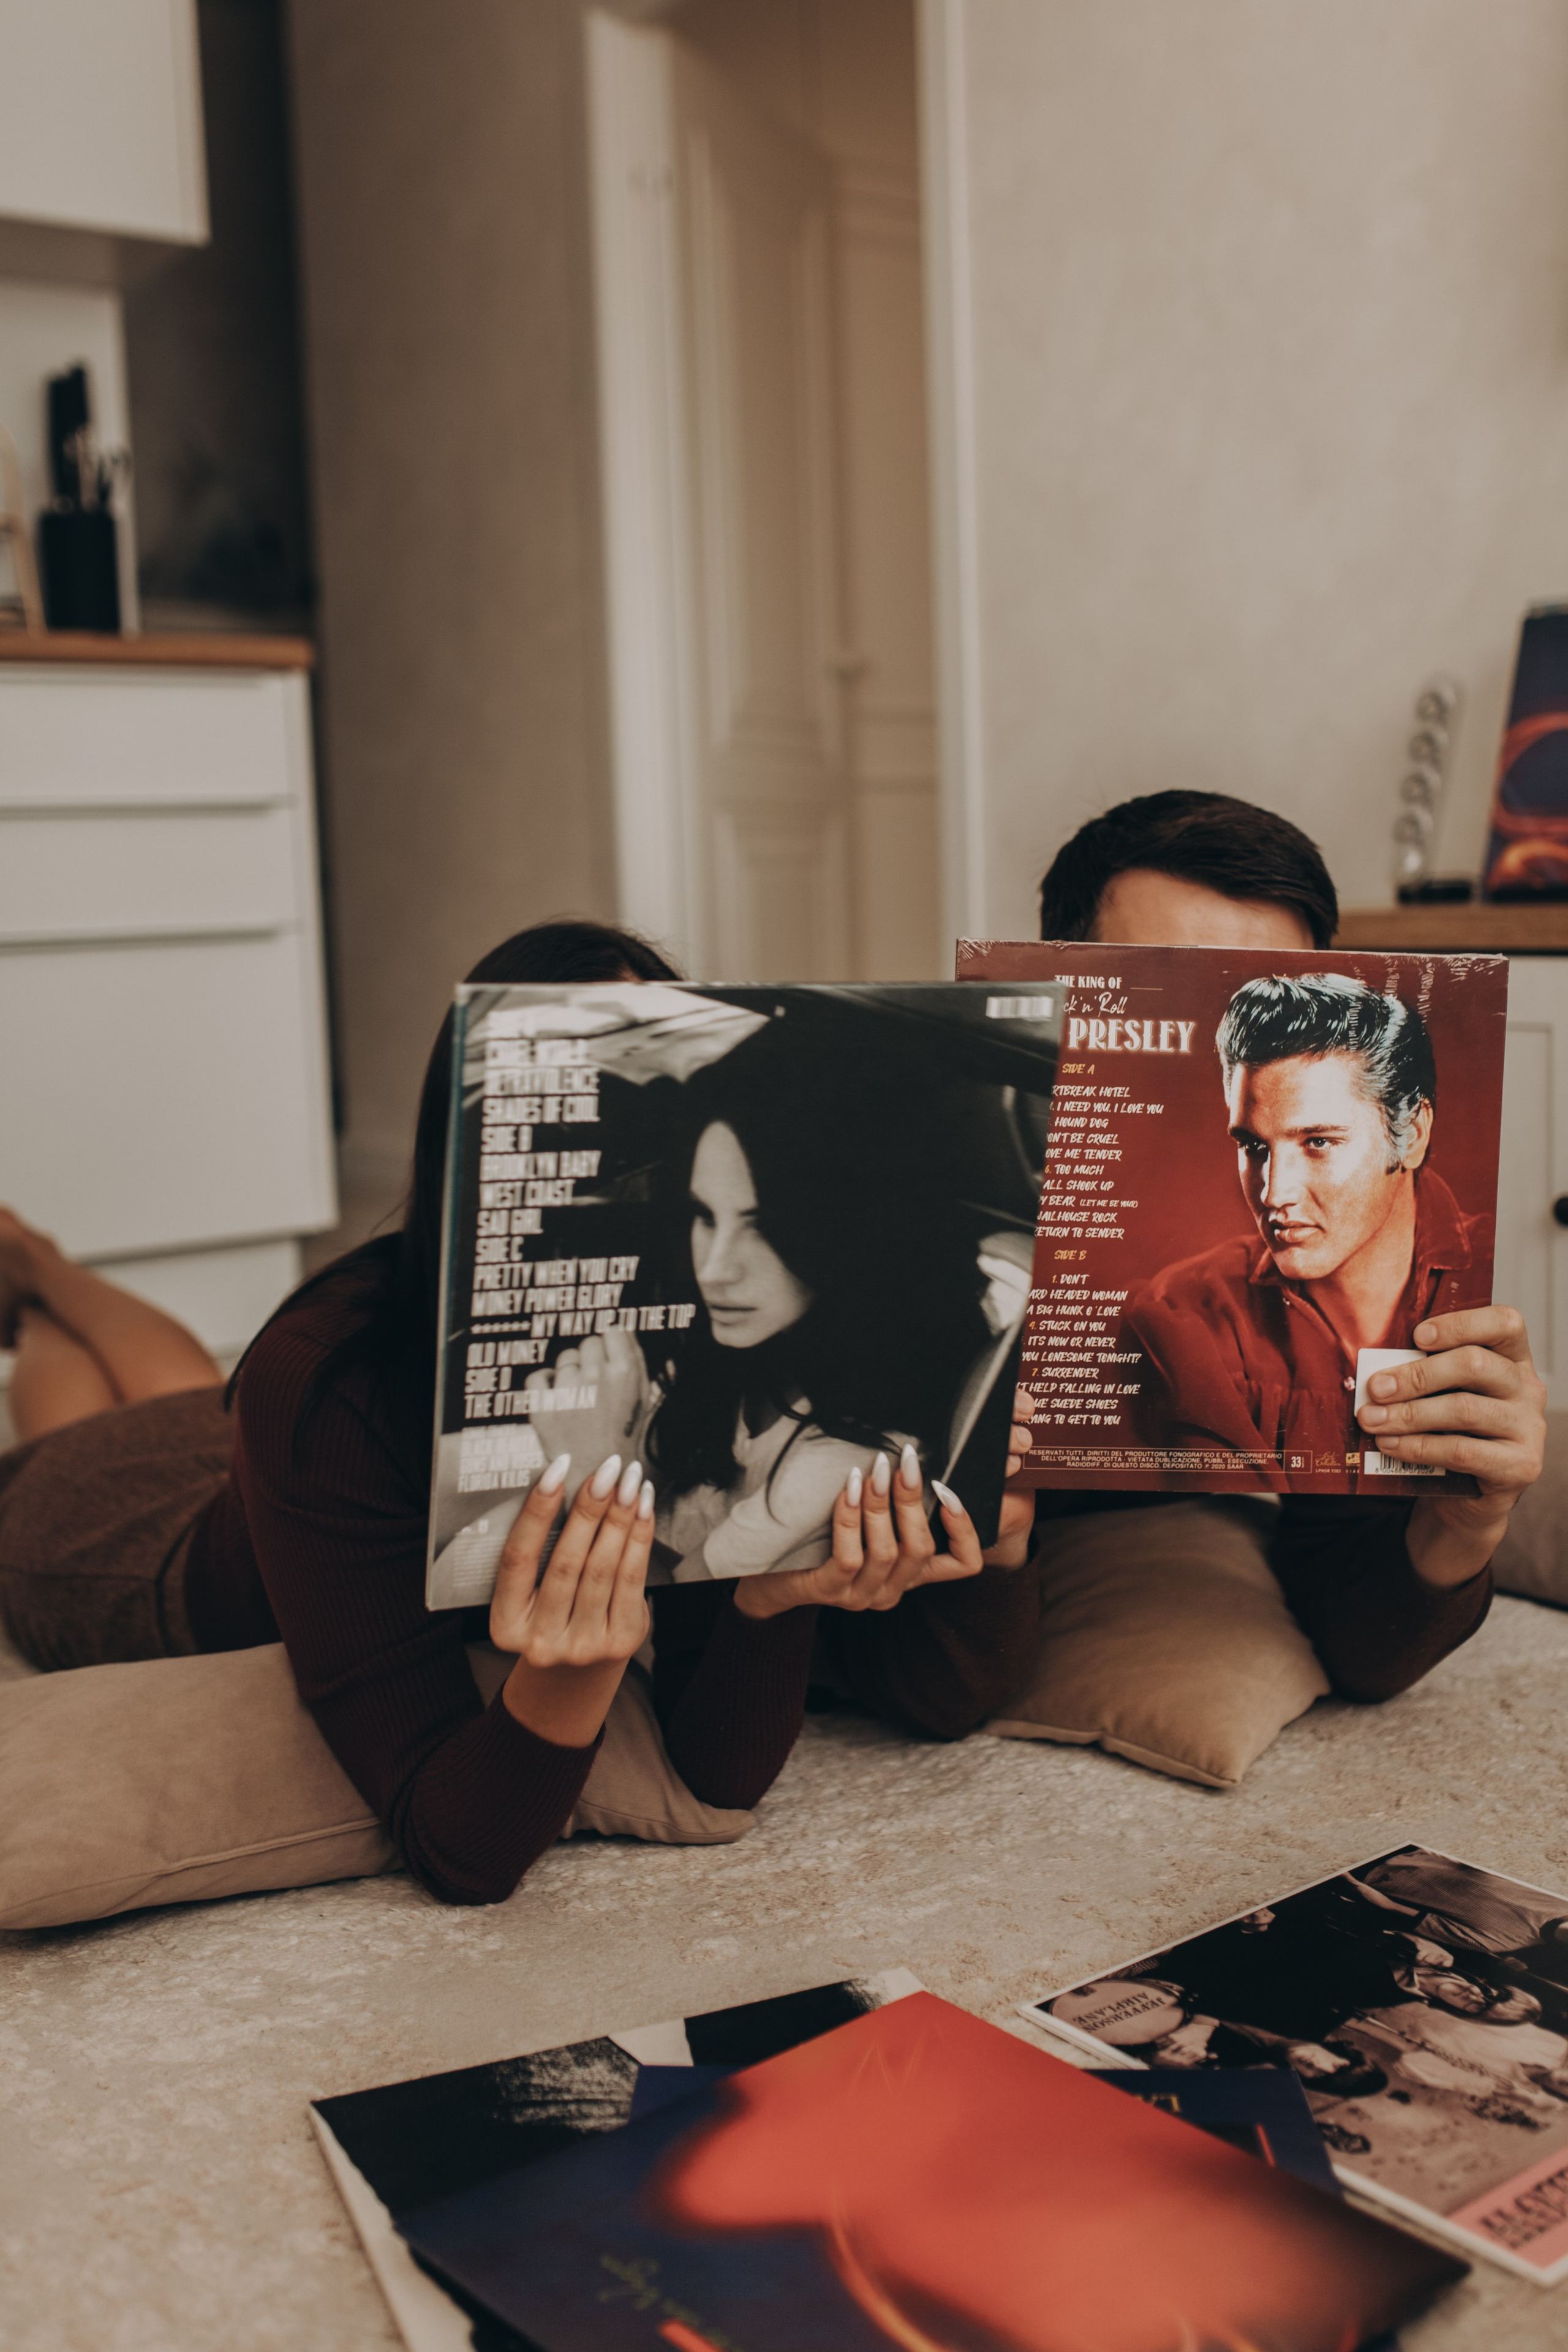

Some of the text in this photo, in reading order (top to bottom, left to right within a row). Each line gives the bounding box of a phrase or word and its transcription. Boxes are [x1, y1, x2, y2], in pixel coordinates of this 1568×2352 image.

[1078, 976, 1105, 989] KING
[1108, 977, 1122, 989] OF
[1068, 1017, 1195, 1053] PRESLEY
[1062, 1063, 1095, 1074] SIDE A
[1099, 1087, 1131, 1097] HOTEL
[1057, 1102, 1061, 1110] I
[1063, 1101, 1091, 1112] NEED
[1114, 1103, 1118, 1112] I
[1120, 1103, 1144, 1114] LOVE
[1147, 1104, 1164, 1114] YOU
[1055, 1117, 1109, 1128] HOUND DOG
[1070, 1133, 1085, 1143] BE
[1087, 1133, 1119, 1145] CRUEL
[1046, 1148, 1122, 1161] OVE ME TENDER
[1044, 1164, 1104, 1175] 6. TOO MUCH
[1043, 1180, 1114, 1191] ALL SHOOK UP
[1049, 1195, 1076, 1207] BEAR
[1037, 1211, 1117, 1224] JAILHOUSE ROCK
[1071, 1227, 1083, 1238] TO
[1085, 1227, 1125, 1240] SENDER
[1054, 1250, 1087, 1259] SIDE B
[1052, 1275, 1057, 1283] 1.
[1028, 1289, 1128, 1301] ARD HEADED WOMAN
[1027, 1305, 1034, 1314] A
[1036, 1304, 1054, 1315] BIG
[1056, 1305, 1084, 1316] HUNK
[1029, 1320, 1106, 1332] 4. STUCK ON YOU
[1048, 1336, 1069, 1347] NOW
[1070, 1337, 1083, 1348] OR
[1085, 1336, 1116, 1348] NEVER
[1022, 1351, 1142, 1363] YOU LONESOME TONIGHT?
[1042, 1367, 1099, 1379] SURRENDER
[1029, 1382, 1057, 1393] HELP
[1059, 1383, 1102, 1394] FALLING
[1104, 1384, 1116, 1393] IN
[1117, 1384, 1140, 1394] LOVE
[1050, 1398, 1084, 1409] SUEDE
[1085, 1399, 1118, 1409] SHOES
[1054, 1414, 1065, 1424] TO
[1068, 1414, 1091, 1425] GET
[1091, 1415, 1101, 1425] TO
[1104, 1415, 1121, 1425] YOU
[1291, 1456, 1302, 1468] 33
[1073, 1992, 1149, 2026] AIRPLANE
[1082, 1997, 1166, 2032] JEFFERSON
